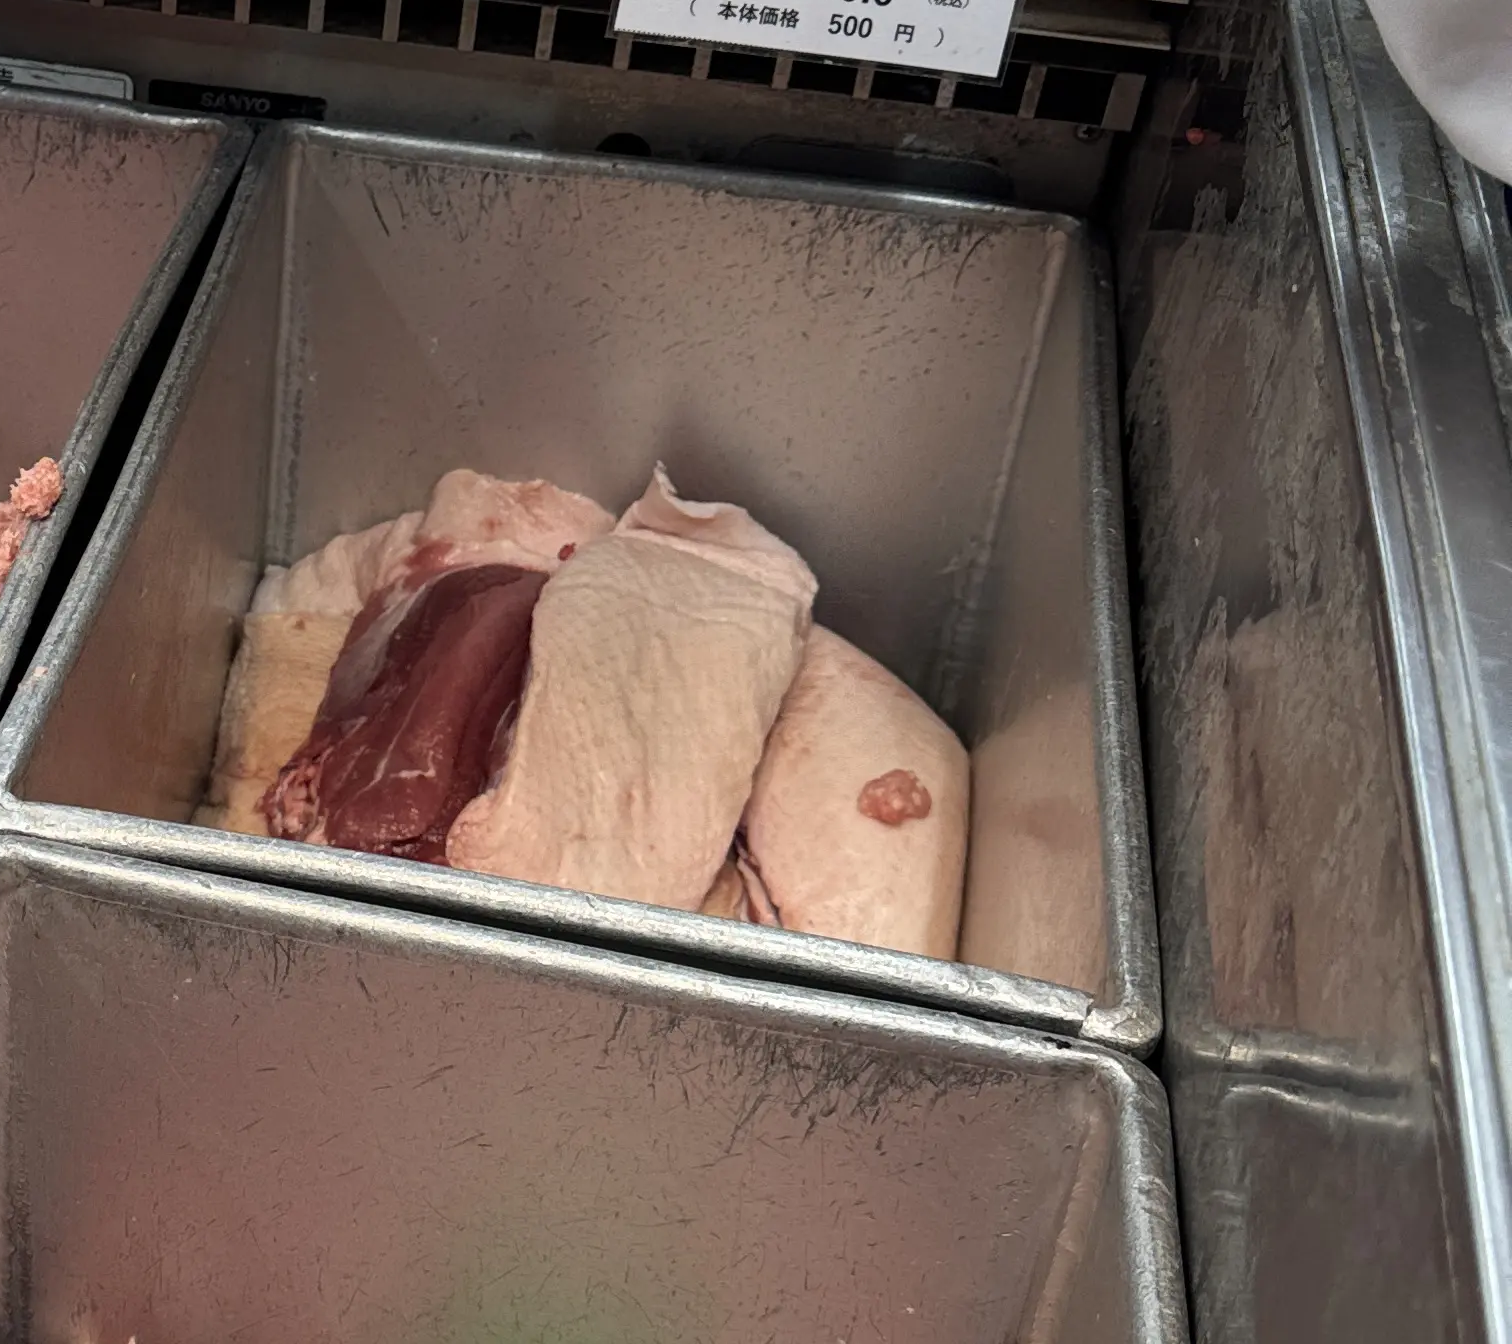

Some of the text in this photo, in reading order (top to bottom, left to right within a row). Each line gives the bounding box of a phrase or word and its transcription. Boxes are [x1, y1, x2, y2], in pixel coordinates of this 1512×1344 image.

[717, 0, 800, 30] 本体価格
[828, 12, 874, 40] 500
[893, 22, 916, 45] 円
[199, 91, 272, 115] SANYO
